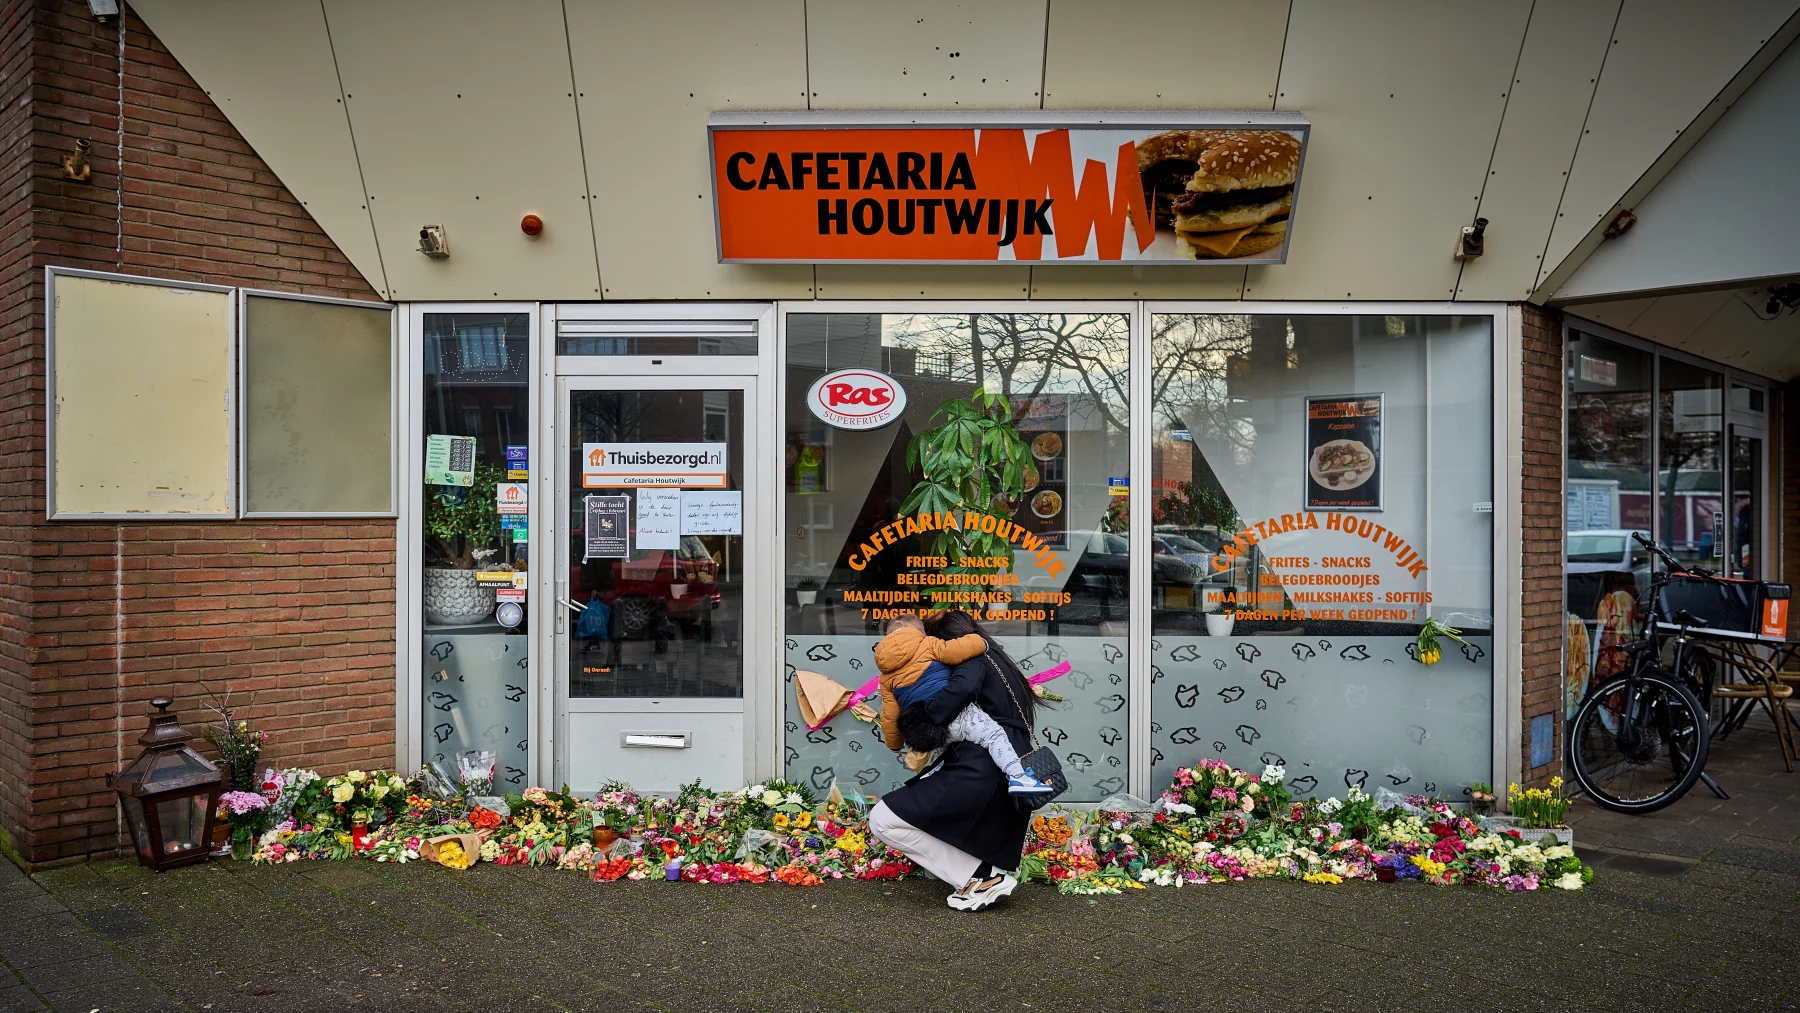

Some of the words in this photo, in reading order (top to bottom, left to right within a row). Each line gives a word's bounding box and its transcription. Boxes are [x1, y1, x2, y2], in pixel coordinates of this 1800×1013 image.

[726, 151, 976, 190] CAFETARIA
[817, 198, 1055, 246] HOUTWIJK
[826, 383, 891, 406] Ras
[1309, 402, 1337, 411] CAFETARIA
[822, 410, 890, 426] SUPERFRITES
[1318, 410, 1347, 418] HOUTWIJK
[1327, 422, 1355, 432] Kapsalon
[608, 451, 722, 468] Thuisbezorgd.nl
[590, 501, 607, 509] Stille
[848, 511, 958, 572] CAFETARIA
[964, 511, 1068, 580] HOUTWIJK
[1212, 511, 1319, 572] CAFETARIA
[1326, 512, 1428, 580] HOUTWIJK
[906, 556, 948, 568] FRITES
[959, 556, 1010, 568] SNACKS
[1269, 556, 1310, 568] FRITES
[1322, 556, 1371, 568] SNACKS
[897, 573, 1019, 588] BELEGDEBROODJES
[1260, 574, 1380, 588] BELEGDEBROODJES
[843, 591, 920, 606] MAALTIJDEN
[931, 591, 1012, 604] MILKSHAKES
[1023, 592, 1072, 606] SOFTIJS
[1207, 592, 1283, 606] MAALTIJDEN
[1294, 592, 1374, 604] MILKSHAKES
[1386, 592, 1433, 606] SOFTIJS
[861, 608, 868, 620] 7
[986, 608, 1046, 621] GEOPEND
[1050, 609, 1054, 620] !
[1224, 609, 1230, 620] 7
[1235, 610, 1278, 620] DAGEN
[1282, 610, 1306, 620] PER
[1310, 610, 1344, 620] WEEK
[1348, 610, 1408, 620] GEOPEND
[1412, 610, 1416, 620] !
